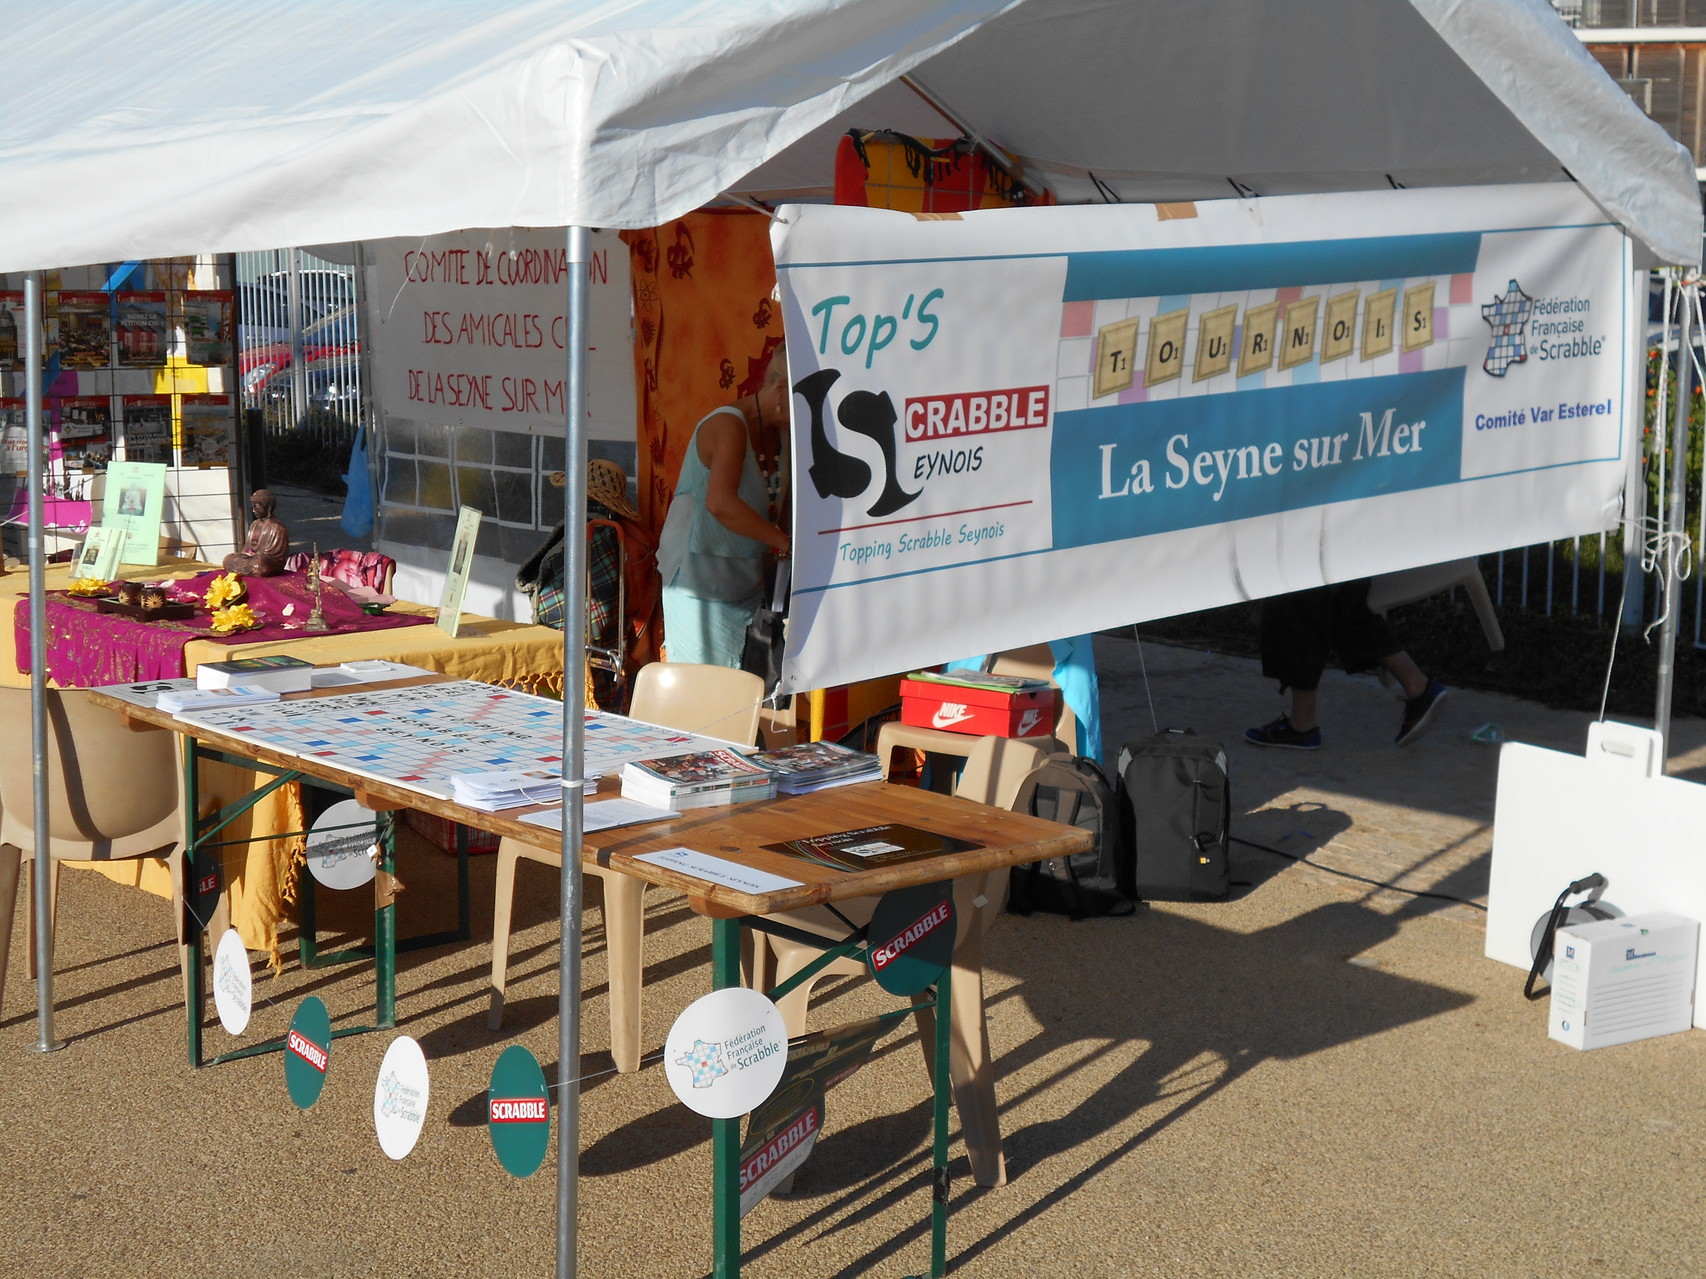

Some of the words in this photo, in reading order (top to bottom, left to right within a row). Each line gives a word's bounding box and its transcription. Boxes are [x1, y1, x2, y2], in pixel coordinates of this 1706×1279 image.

[476, 249, 494, 286] DE
[1532, 296, 1591, 316] Fédération
[423, 311, 454, 345] DES
[457, 312, 544, 349] AMICALES
[811, 288, 945, 370] Top'S
[1530, 317, 1585, 338] Française
[408, 368, 424, 402] DE
[501, 376, 541, 414] SUR
[906, 389, 1047, 440] CRABBLE
[1475, 409, 1527, 431] Comité
[1531, 406, 1555, 423] Var
[1558, 398, 1612, 420] Esterel
[913, 446, 984, 480] EYNOIS
[1098, 443, 1155, 500] La
[1165, 433, 1284, 502] Seyne
[1292, 431, 1350, 473] sur
[1352, 408, 1427, 462] Mer
[839, 540, 893, 565] Topping
[898, 531, 953, 553] Scrabble
[957, 521, 1005, 544] Seynois
[939, 702, 968, 718] NIKE
[1022, 709, 1039, 725] NIKE
[874, 903, 949, 968] SCRABBLE
[289, 1033, 328, 1070] SCRABBLE
[724, 1024, 767, 1050] Fédération
[726, 1037, 764, 1061] Française
[492, 1101, 546, 1120] SCRABBLE
